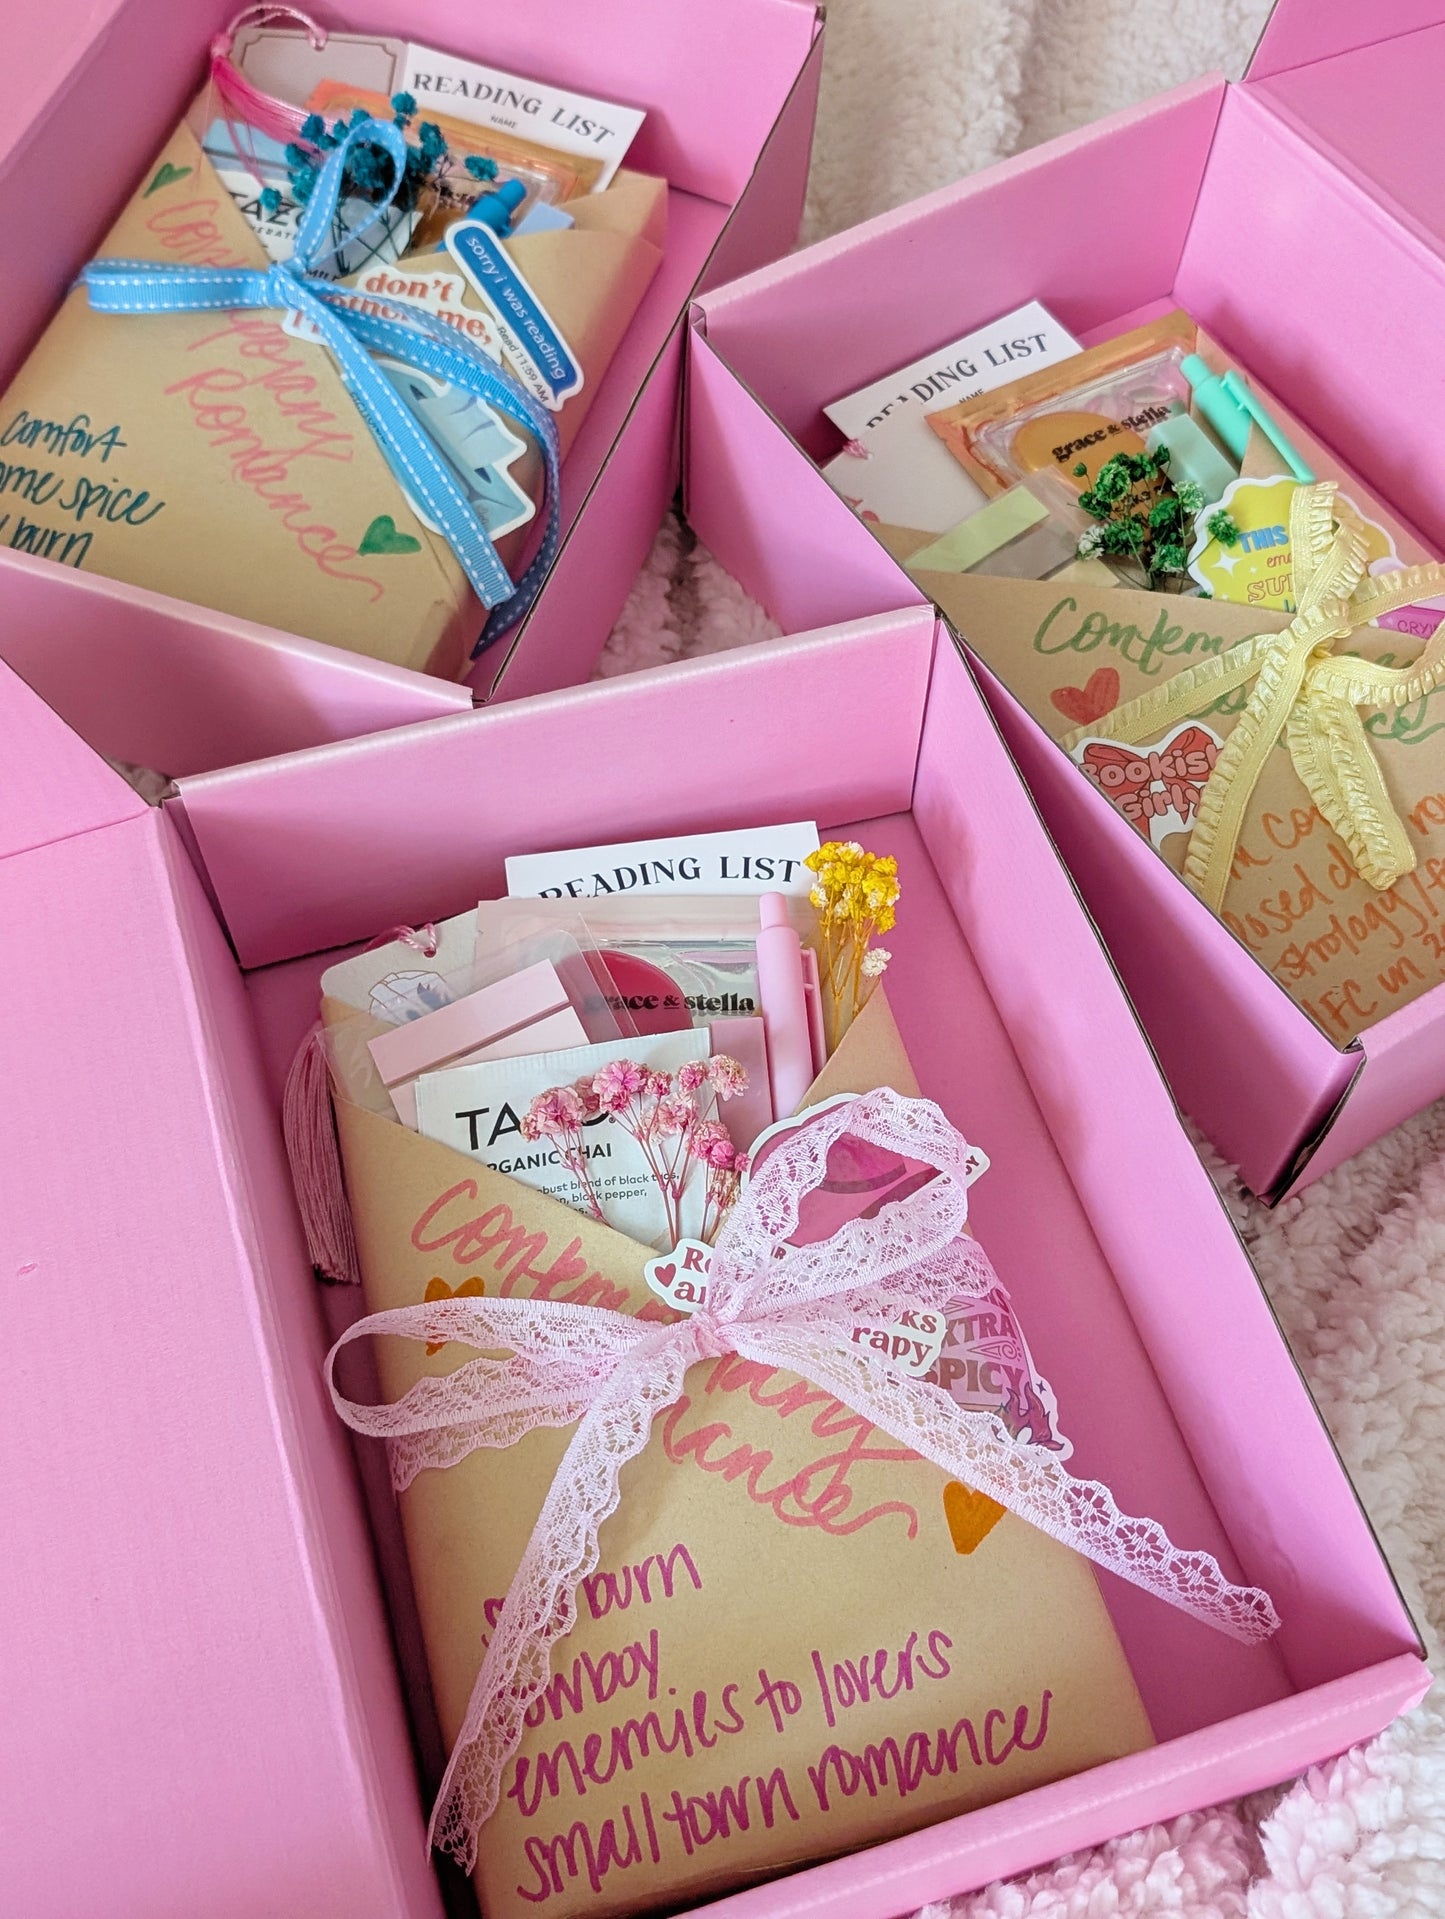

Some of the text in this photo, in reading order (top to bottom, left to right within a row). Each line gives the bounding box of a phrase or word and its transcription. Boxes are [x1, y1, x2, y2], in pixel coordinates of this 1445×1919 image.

[413, 72, 616, 145] READING LIST
[490, 115, 519, 130] NAME
[365, 273, 455, 302] don't
[465, 236, 500, 275] sorry
[502, 288, 529, 319] was
[523, 319, 567, 380] reading
[497, 327, 549, 403] Read 11:59 AM
[983, 333, 1049, 368] LIST
[1051, 406, 1171, 463] grace & stella
[59, 477, 166, 526] spice
[10, 516, 94, 568] burn
[1238, 525, 1289, 553] THIS
[719, 855, 801, 883] LIST
[664, 994, 680, 1010] &
[684, 993, 756, 1012] stella
[604, 1176, 617, 1186] of
[619, 1173, 649, 1186] black
[604, 1189, 648, 1201] pepper,
[582, 1543, 703, 1619] burn
[507, 1629, 953, 1817] enemies to lovers
[808, 1689, 1054, 1812] romance
